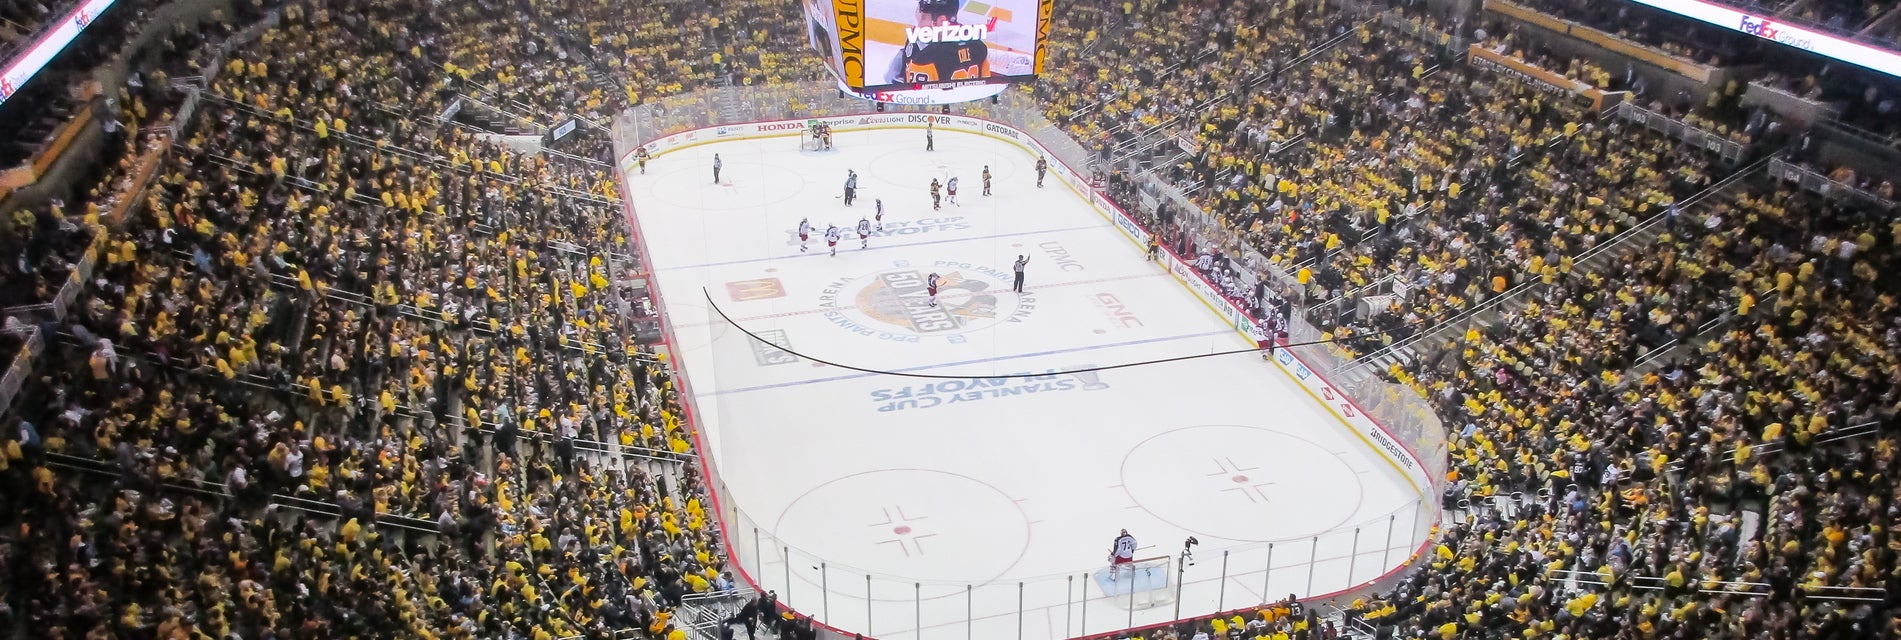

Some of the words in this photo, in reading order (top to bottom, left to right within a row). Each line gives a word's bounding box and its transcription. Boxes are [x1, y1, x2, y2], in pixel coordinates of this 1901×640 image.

[905, 21, 987, 43] verizon
[1740, 15, 1778, 40] FedEx
[1779, 31, 1811, 49] Ground
[896, 94, 929, 104] Ground
[757, 122, 805, 131] HONDA
[908, 115, 951, 125] DISCOVER
[1632, 113, 1646, 124] 103
[986, 123, 1019, 140] GATORADE
[1706, 140, 1721, 153] 103
[1117, 213, 1140, 239] GEICO
[1039, 241, 1084, 272] UPMC
[885, 269, 923, 289] 50
[819, 276, 854, 307] ARENA
[934, 260, 972, 270] PPG
[1007, 291, 1035, 323] ARENA
[1096, 293, 1144, 328] GNC
[824, 310, 875, 337] PAINTS
[879, 333, 920, 343] PPG
[1279, 350, 1292, 365] SAP
[1296, 364, 1308, 379] SAP
[870, 368, 1056, 401] PLAYOFFS
[948, 378, 1075, 404] STANLEY
[877, 396, 942, 412] CUP
[1370, 427, 1414, 470] BRIDGESTONE
[1290, 606, 1300, 617] 13
